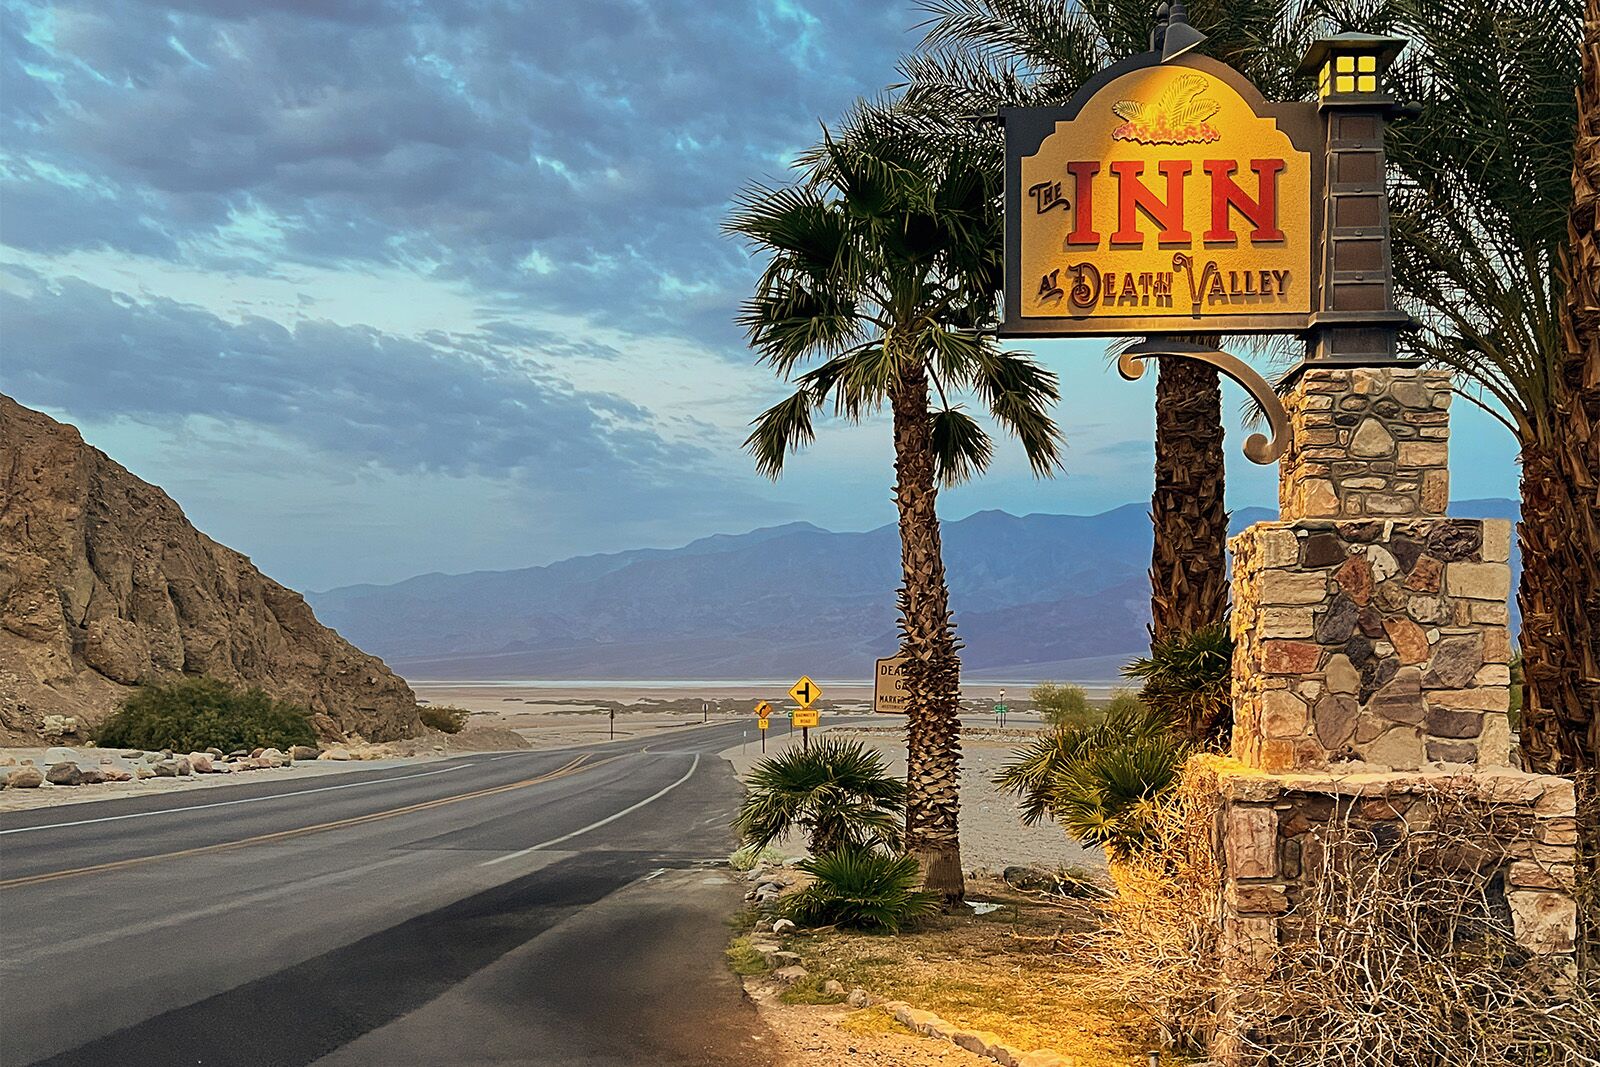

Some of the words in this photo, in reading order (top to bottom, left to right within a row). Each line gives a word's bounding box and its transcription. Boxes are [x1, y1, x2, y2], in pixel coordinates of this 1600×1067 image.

[1028, 181, 1070, 214] THE
[1067, 159, 1285, 244] INN
[1066, 262, 1173, 308] DEATH
[1172, 253, 1290, 305] VALLEY
